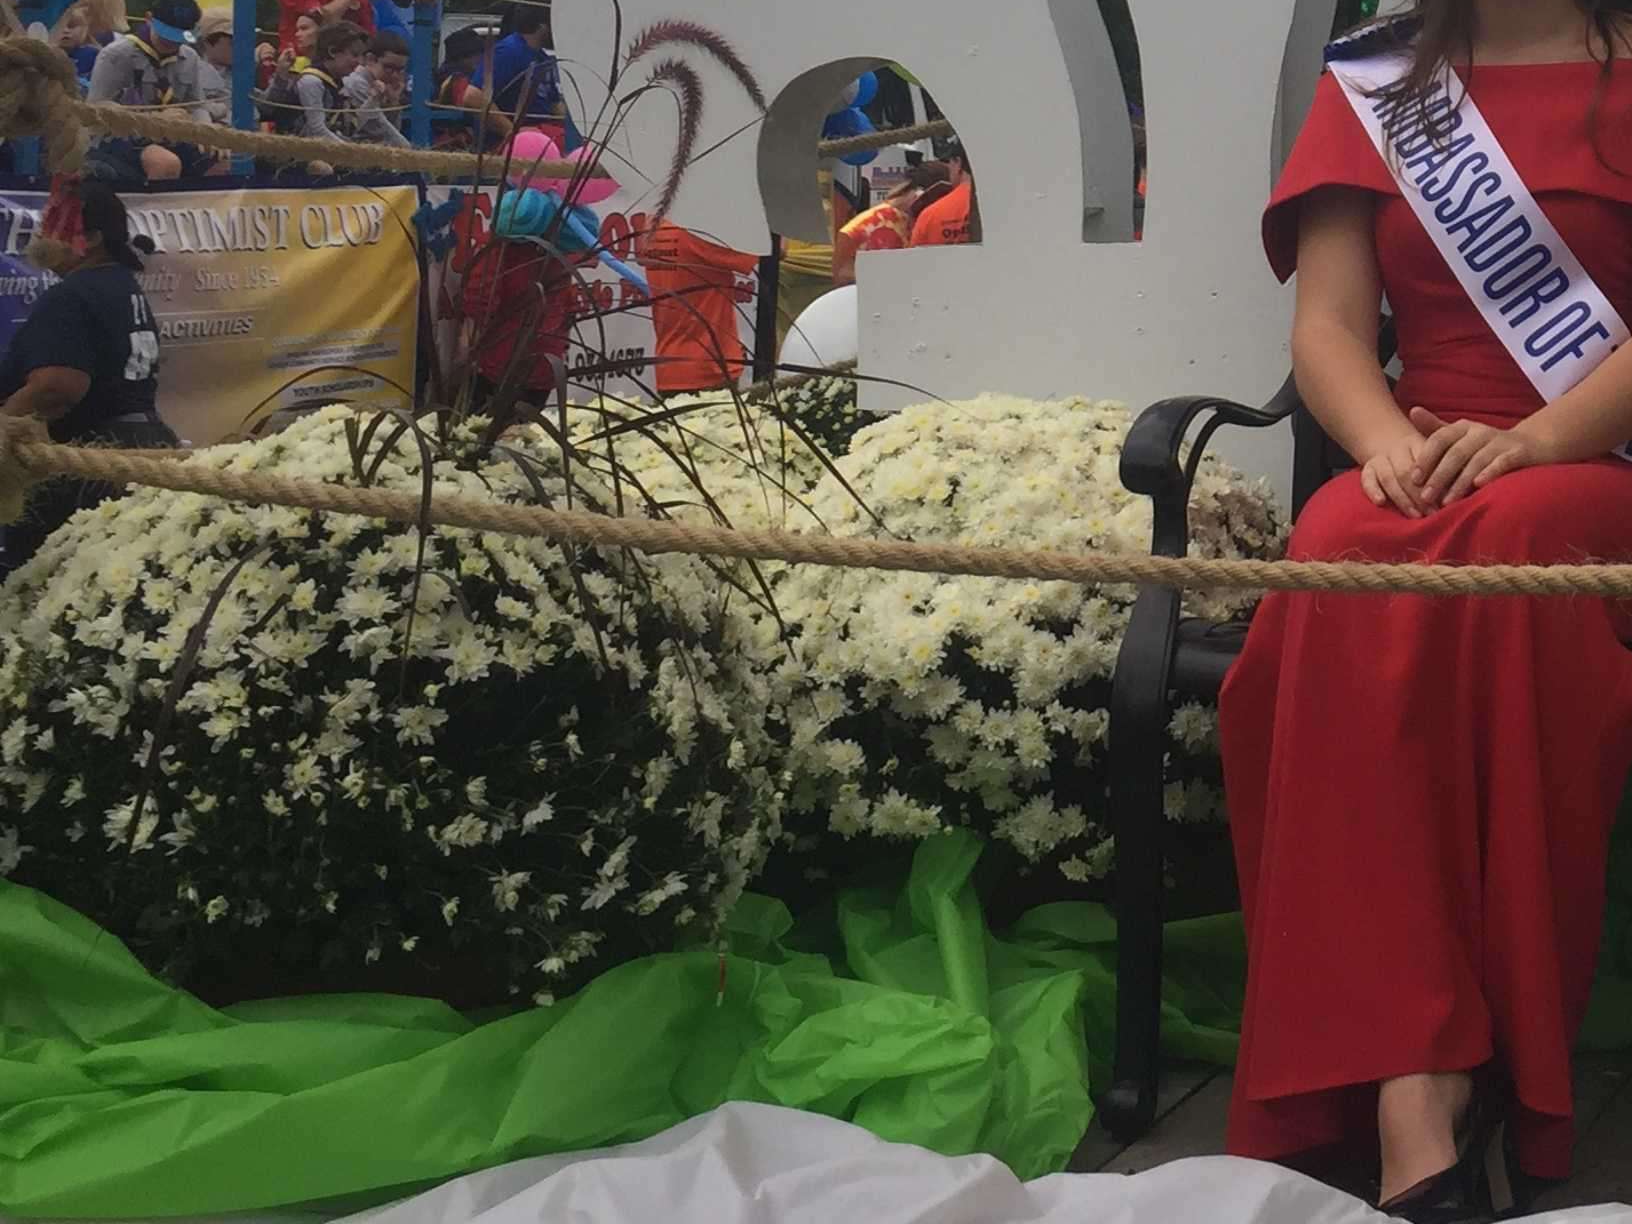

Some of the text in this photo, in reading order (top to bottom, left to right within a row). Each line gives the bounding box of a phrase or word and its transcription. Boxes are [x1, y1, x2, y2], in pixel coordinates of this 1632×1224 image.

[300, 201, 385, 250] CLUB
[1370, 77, 1611, 373] AMBASSADOR OF
[160, 317, 254, 341] ACTIVITIES
